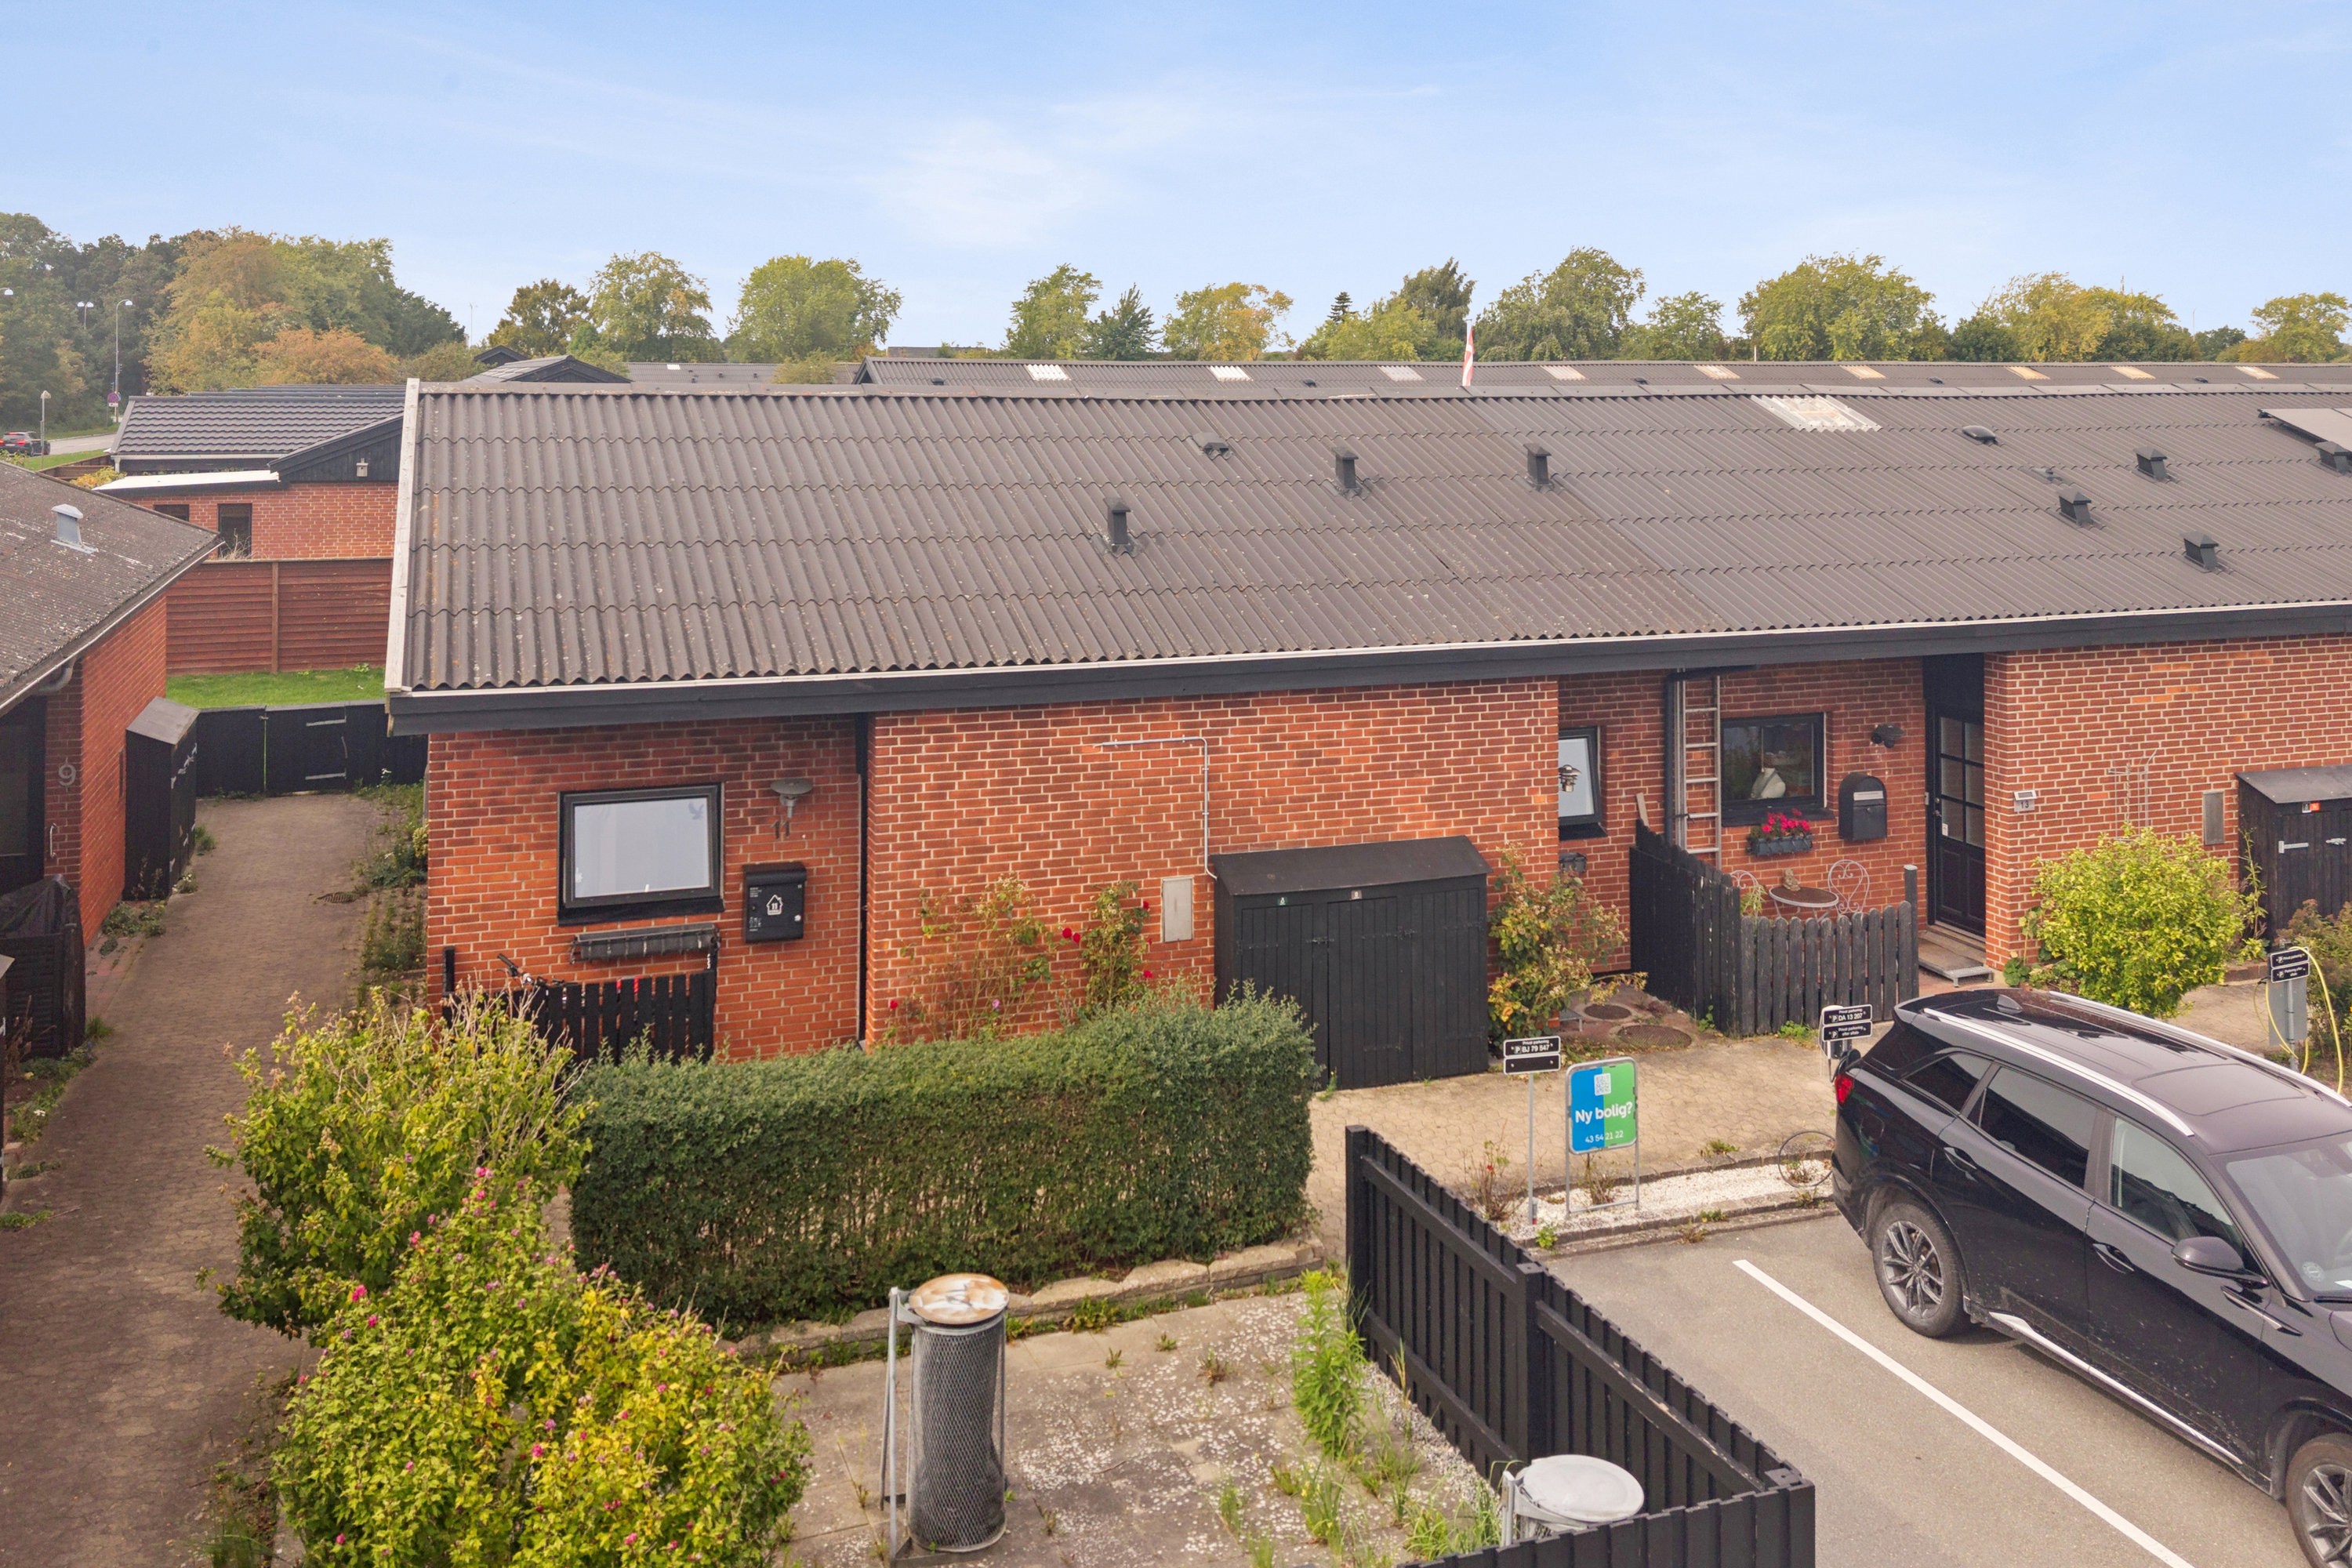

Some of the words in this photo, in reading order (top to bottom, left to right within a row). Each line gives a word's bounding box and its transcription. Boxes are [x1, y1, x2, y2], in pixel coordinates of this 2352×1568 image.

[59, 764, 76, 786] 9
[770, 820, 790, 839] 11
[1575, 1109, 1592, 1124] Ny
[1595, 1102, 1633, 1120] bolig?
[1605, 1132, 1613, 1141] 21
[1615, 1130, 1624, 1138] 22
